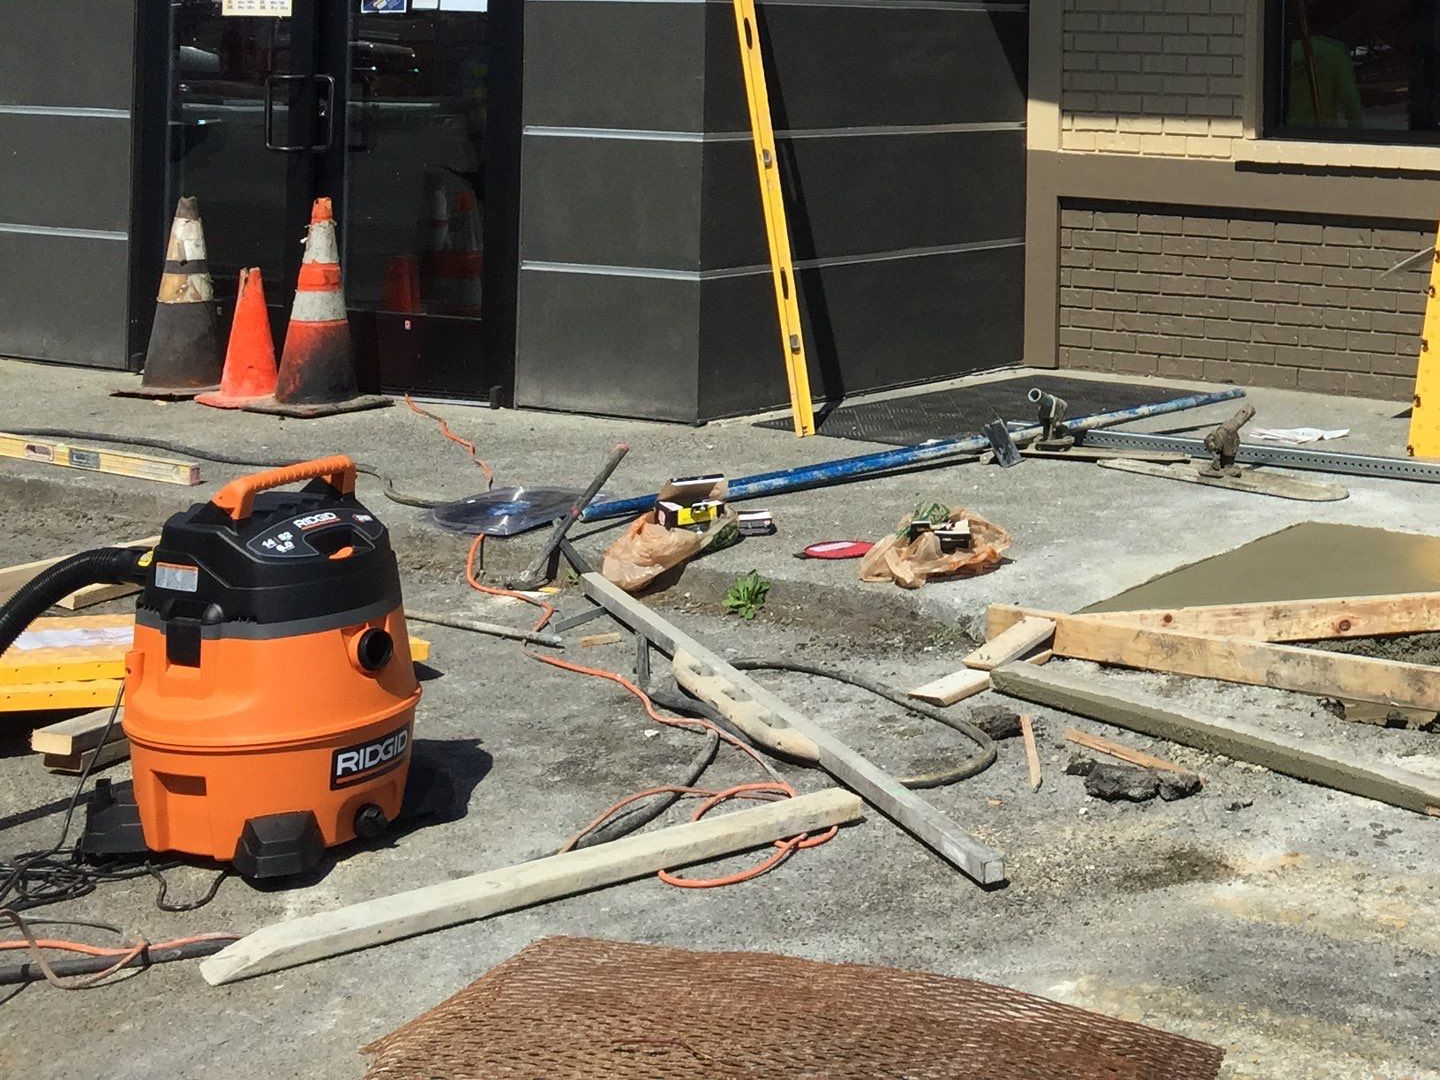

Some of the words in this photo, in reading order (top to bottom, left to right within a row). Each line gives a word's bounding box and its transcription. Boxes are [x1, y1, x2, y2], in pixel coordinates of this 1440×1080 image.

[293, 512, 337, 528] RIDGID
[261, 538, 277, 549] 14
[336, 729, 408, 776] RIDGID
